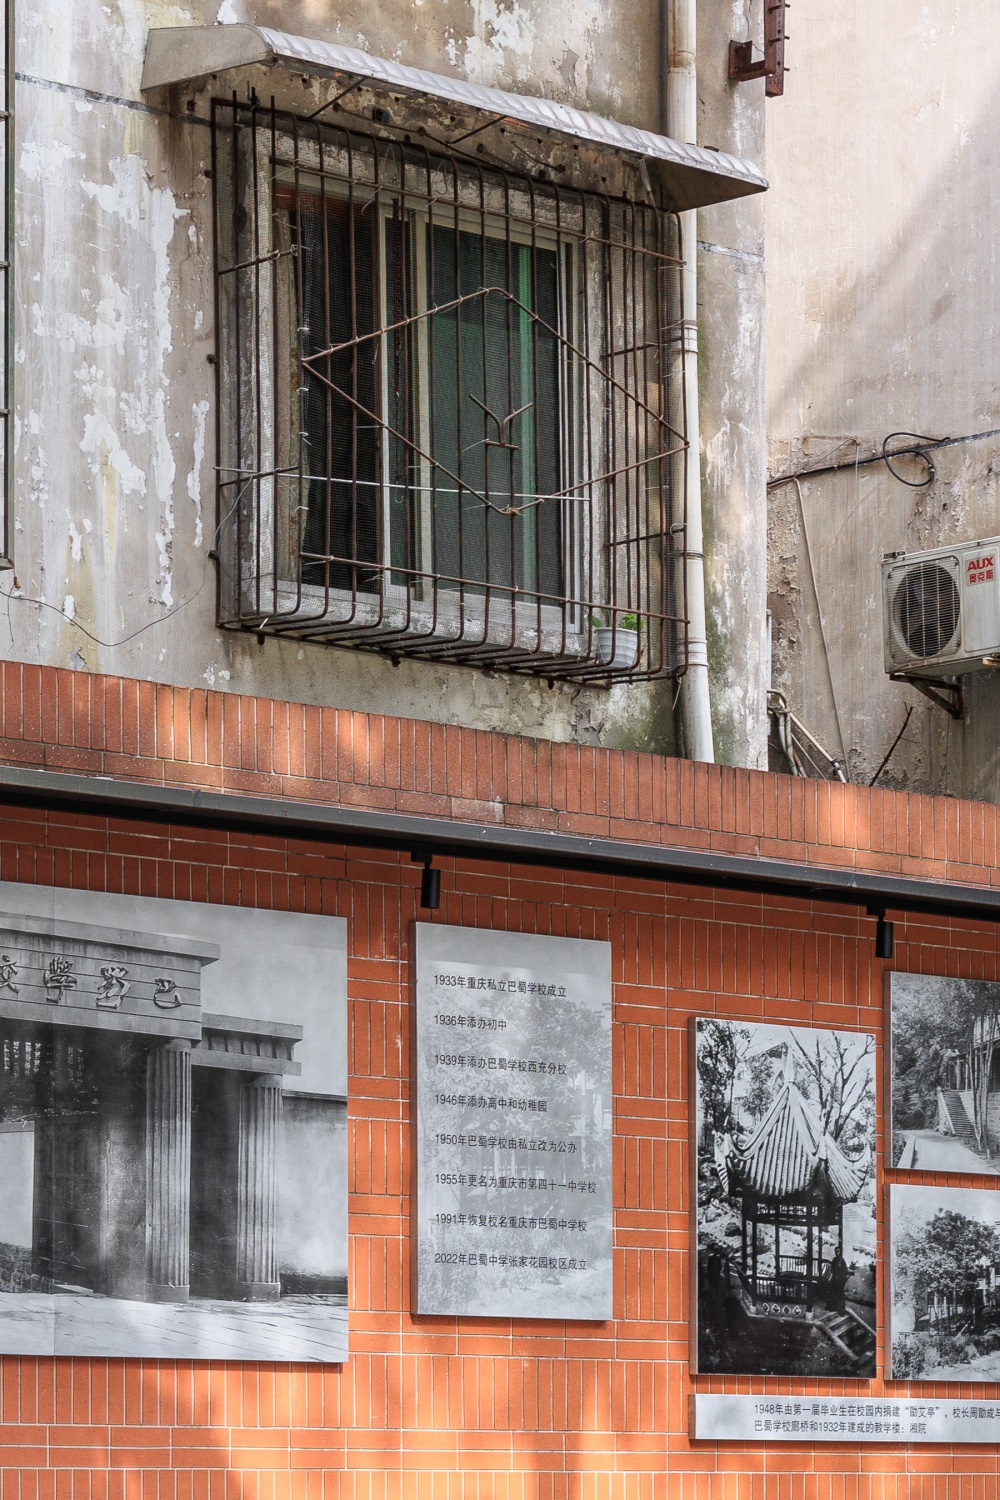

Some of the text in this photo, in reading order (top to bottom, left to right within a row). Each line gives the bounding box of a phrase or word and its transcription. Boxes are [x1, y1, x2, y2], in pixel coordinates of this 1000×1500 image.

[967, 556, 994, 572] AUX
[969, 569, 994, 584] 奥克斯
[434, 975, 567, 998] 1933年重庆私立巴蜀学校成立
[434, 1014, 507, 1032] 1936年添办初中
[434, 1054, 567, 1076] 1939年添办巴蜀学校西充分校
[435, 1094, 548, 1113] 1946年添办高中和幼稚园
[435, 1134, 578, 1154] 1950年巴蜀学校由私立改为公办
[435, 1173, 598, 1194] 1955年更名为重庆市第四十一中学校
[435, 1213, 588, 1232] 1991年恢复校名重庆市巴蜀中学校
[435, 1252, 588, 1271] 2022年巴蜀中学张家花园校区成立
